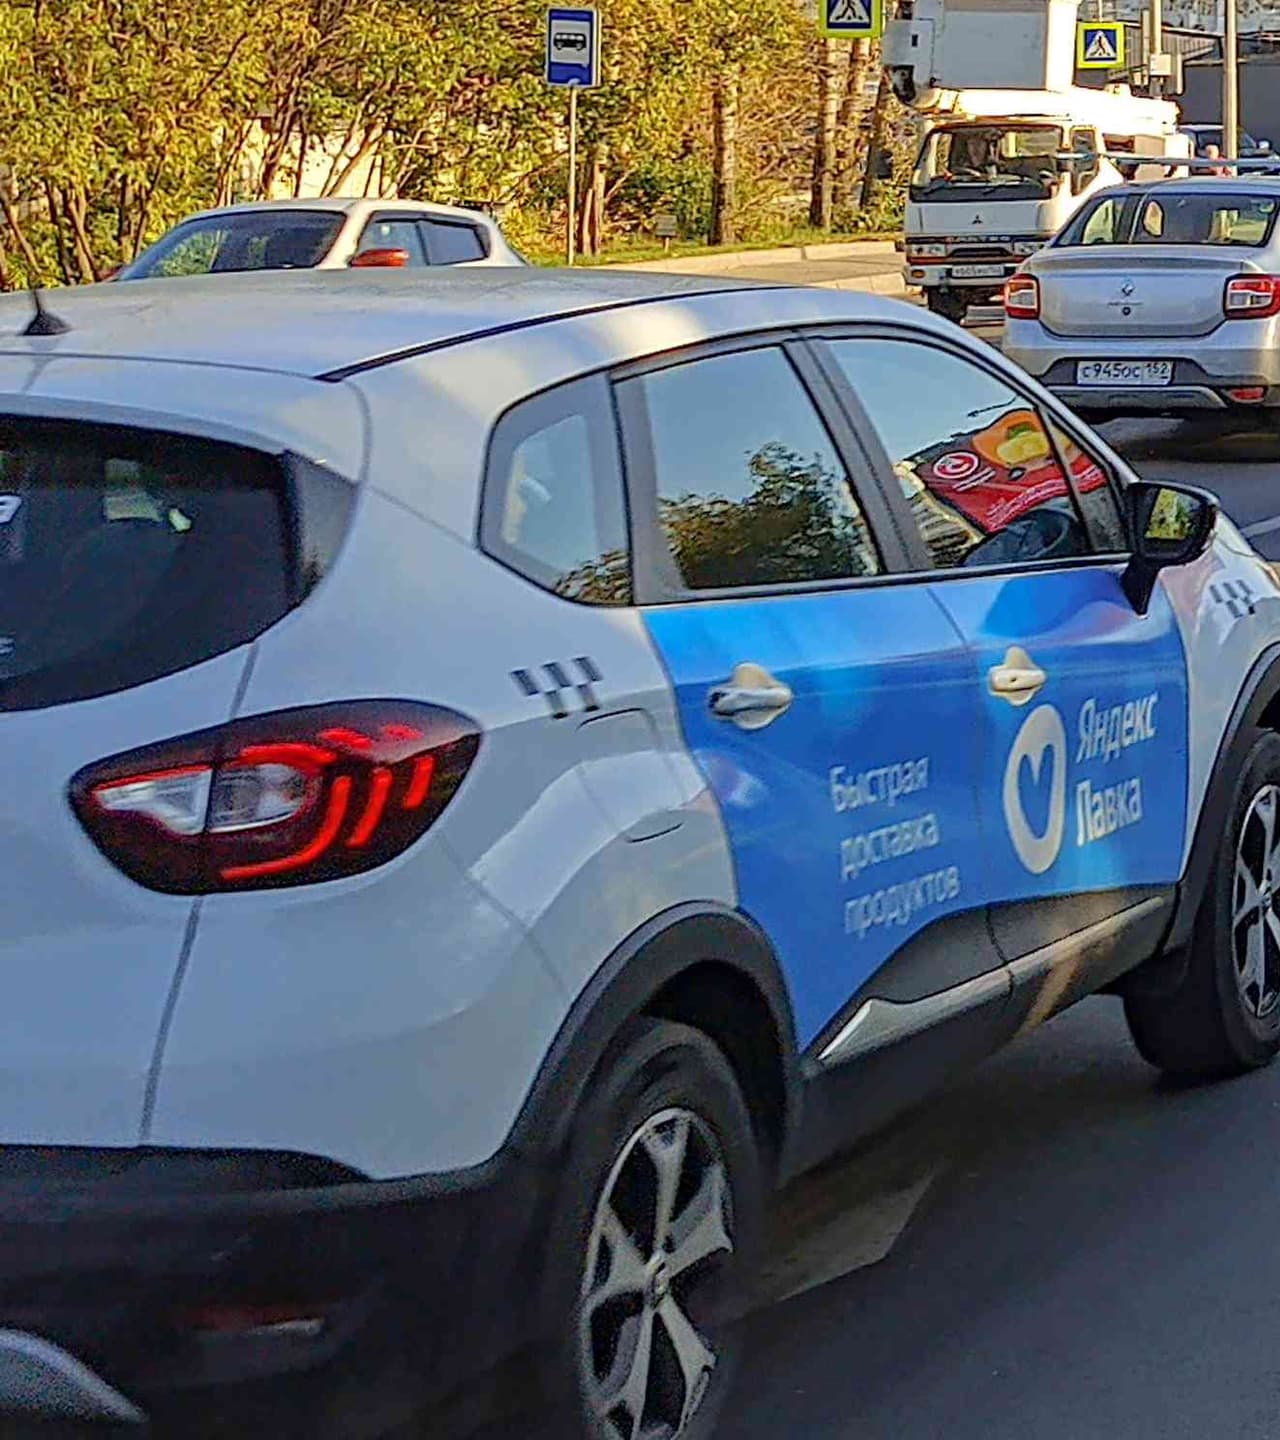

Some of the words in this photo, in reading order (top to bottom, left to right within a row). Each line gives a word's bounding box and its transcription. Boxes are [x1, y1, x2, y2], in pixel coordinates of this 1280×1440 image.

[1075, 692, 1158, 764] Яндекс
[830, 756, 929, 814] Быстрая
[1075, 777, 1143, 848] Лавка
[840, 813, 940, 881] доставка
[845, 865, 960, 941] продуктов
